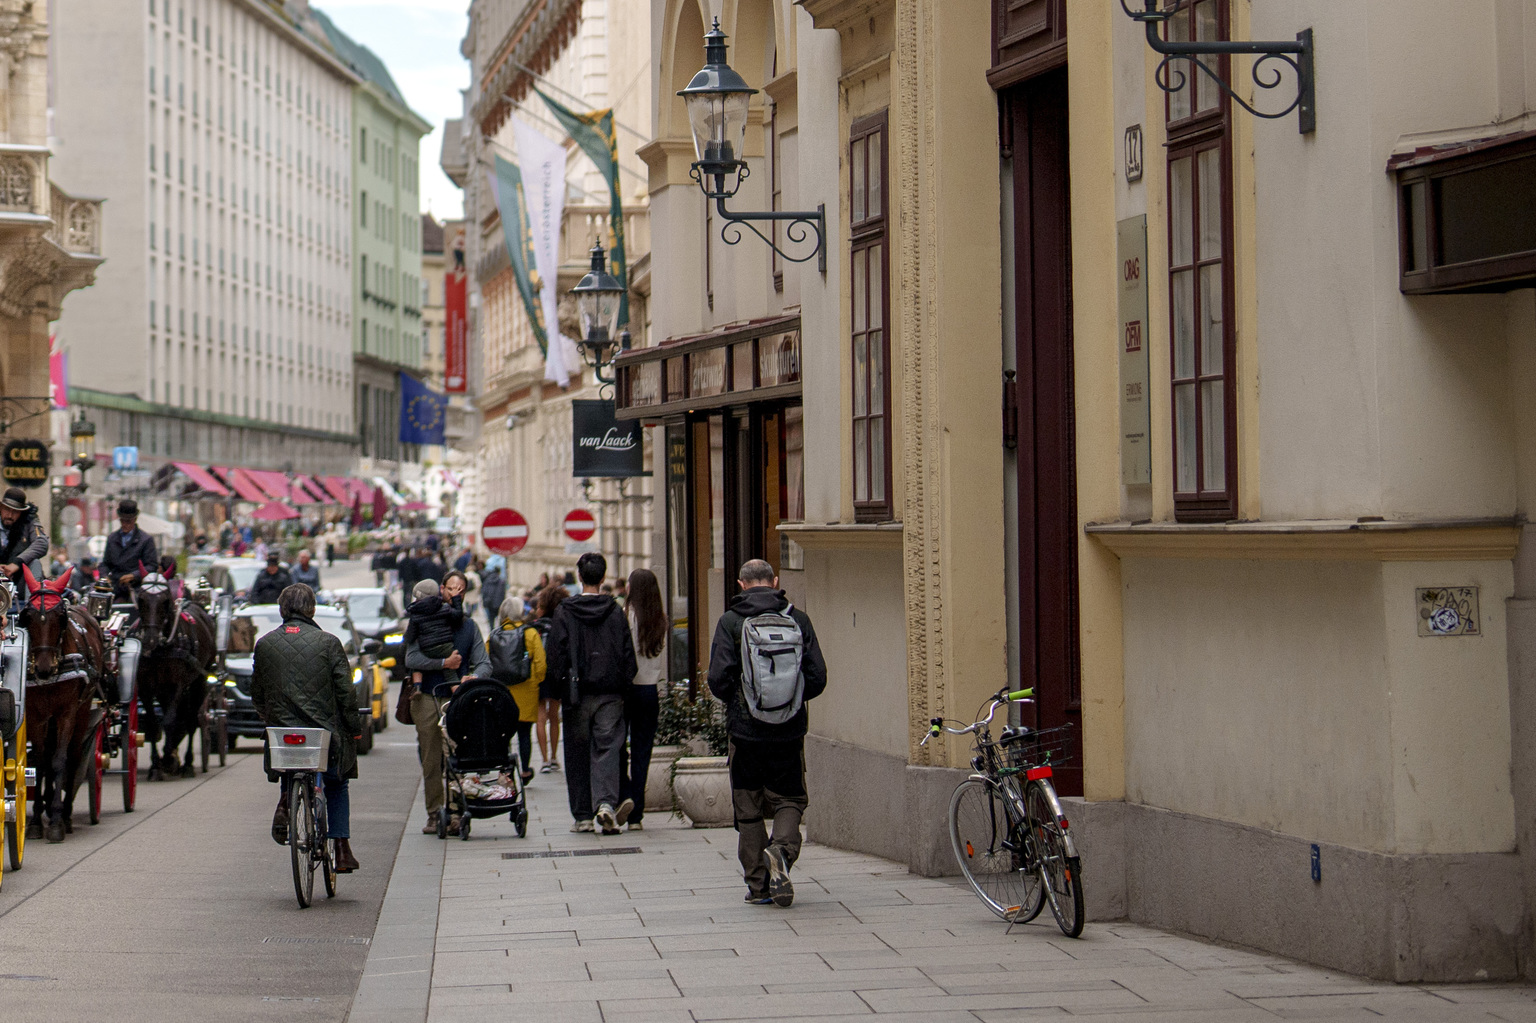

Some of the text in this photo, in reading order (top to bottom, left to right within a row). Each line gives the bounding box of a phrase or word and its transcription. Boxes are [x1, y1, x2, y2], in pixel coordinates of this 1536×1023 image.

[1128, 131, 1138, 164] 17
[1124, 257, 1140, 282] ORAG
[1125, 322, 1141, 348] ÖFM
[115, 451, 133, 468] U
[3, 466, 47, 479] CENTRAL
